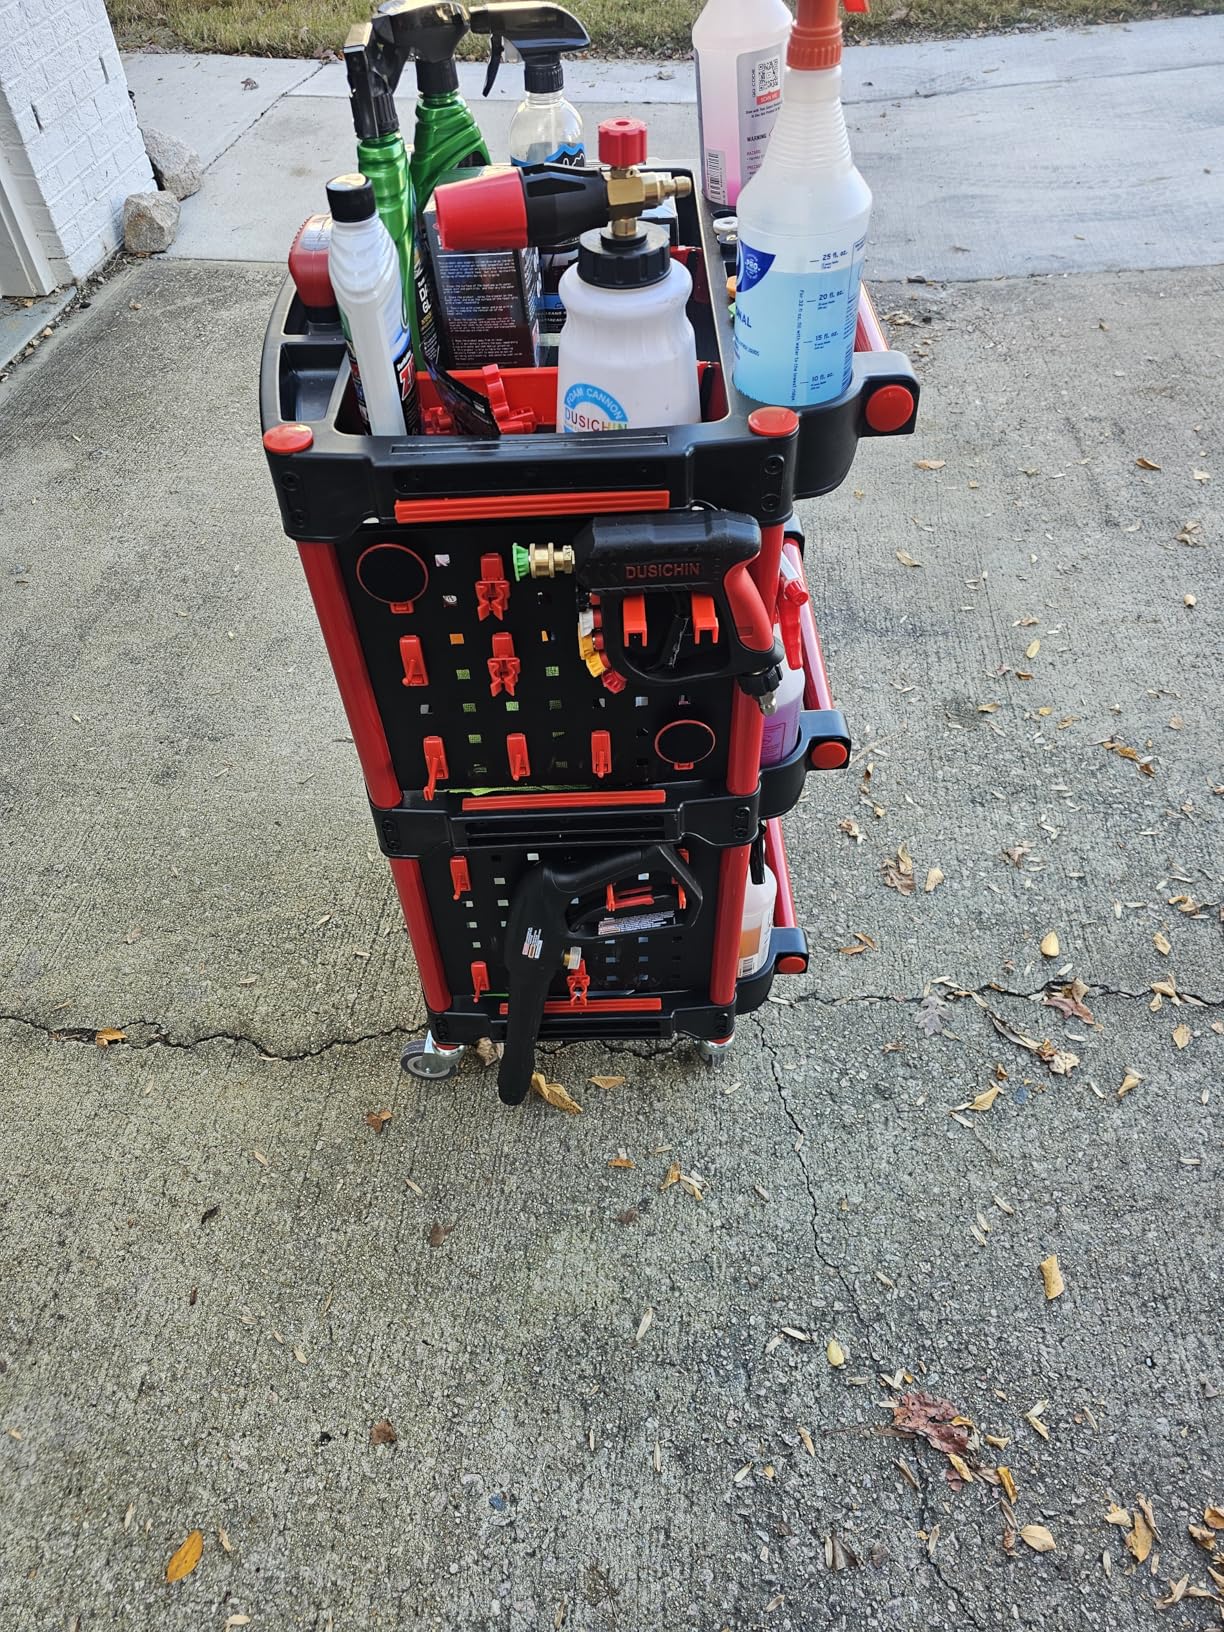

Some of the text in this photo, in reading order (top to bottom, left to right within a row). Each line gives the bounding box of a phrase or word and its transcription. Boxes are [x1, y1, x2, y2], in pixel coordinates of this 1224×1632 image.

[746, 133, 767, 142] WARNING
[567, 387, 623, 419] FOAM CANNON
[565, 407, 628, 432] DUSICHIN
[625, 563, 700, 579] DUSICHIN
